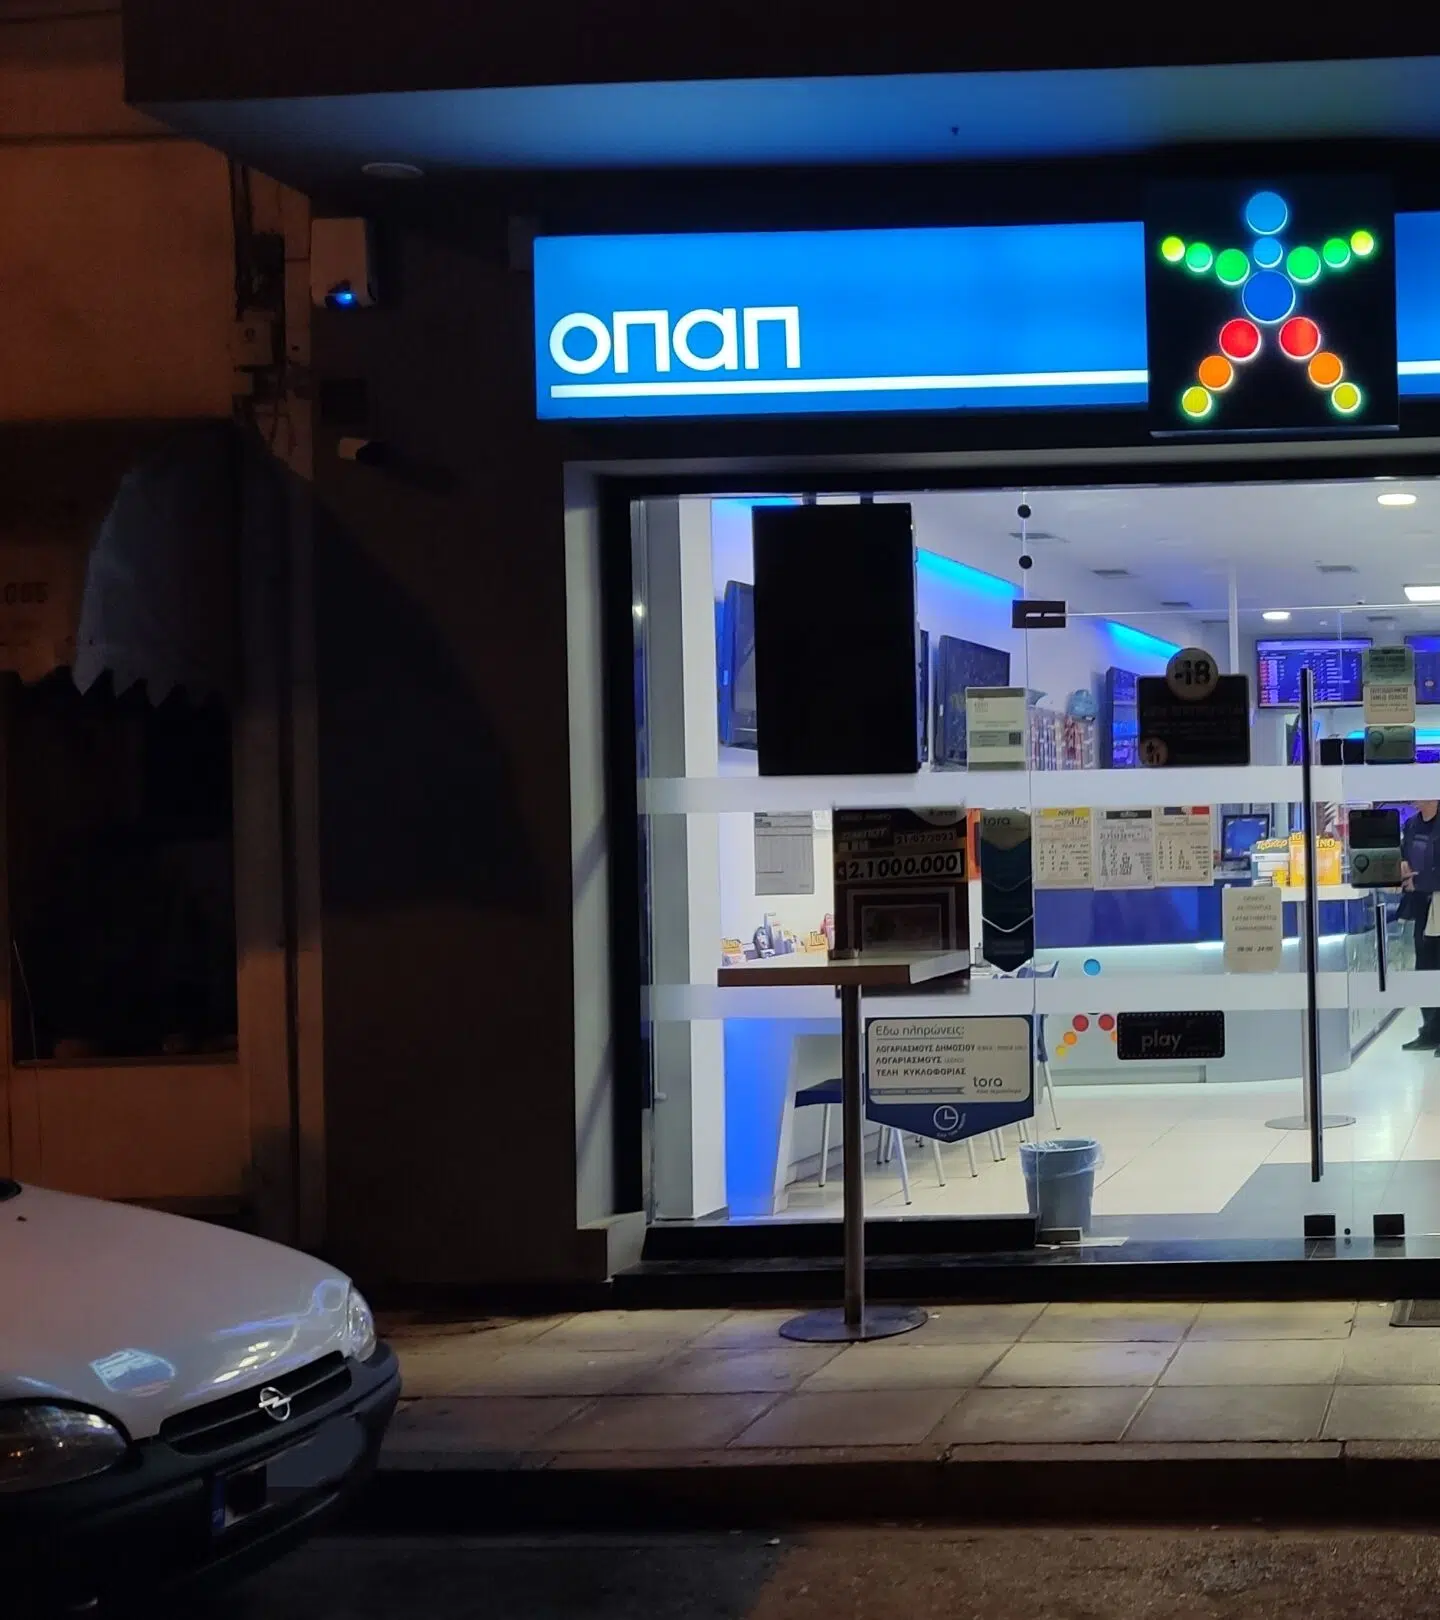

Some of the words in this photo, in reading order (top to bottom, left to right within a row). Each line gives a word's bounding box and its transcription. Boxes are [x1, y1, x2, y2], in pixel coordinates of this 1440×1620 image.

[1141, 1029, 1183, 1053] play
[876, 1068, 899, 1078] ΤΕΛΗ
[903, 1067, 967, 1077] ΚΥΚΛΟΦΟΡΙΑΣ
[973, 1076, 1004, 1088] tora
